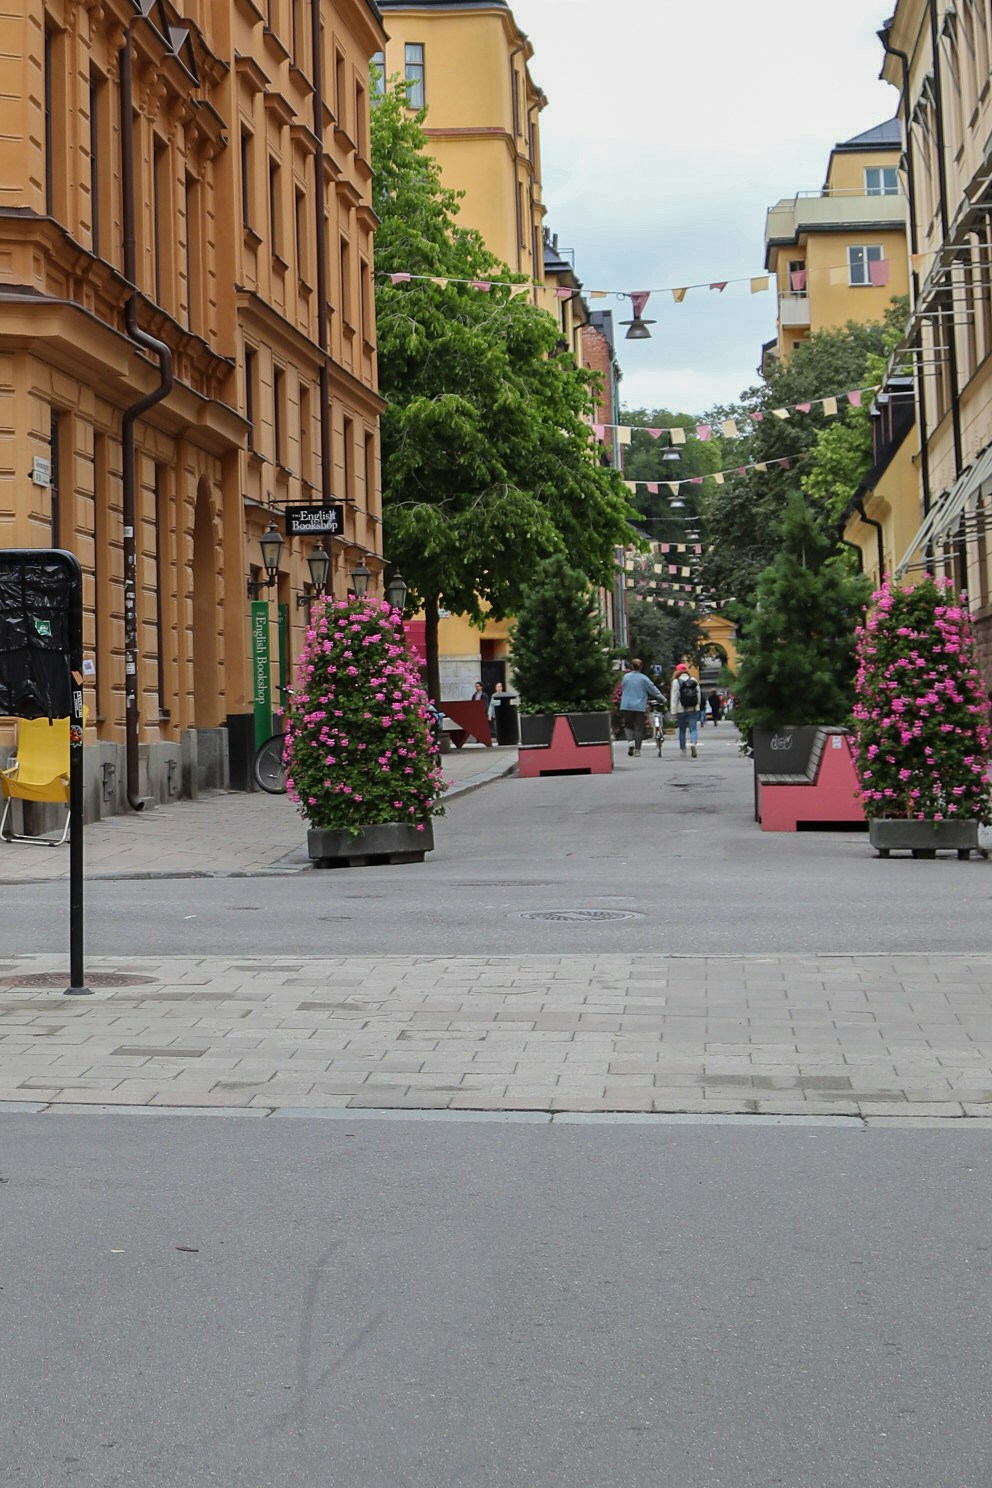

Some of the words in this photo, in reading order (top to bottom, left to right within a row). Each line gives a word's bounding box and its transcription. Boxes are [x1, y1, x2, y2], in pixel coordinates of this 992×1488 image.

[292, 519, 338, 532] Bookshop
[300, 509, 336, 523] English
[254, 616, 267, 653] English
[255, 656, 268, 704] Bookshop
